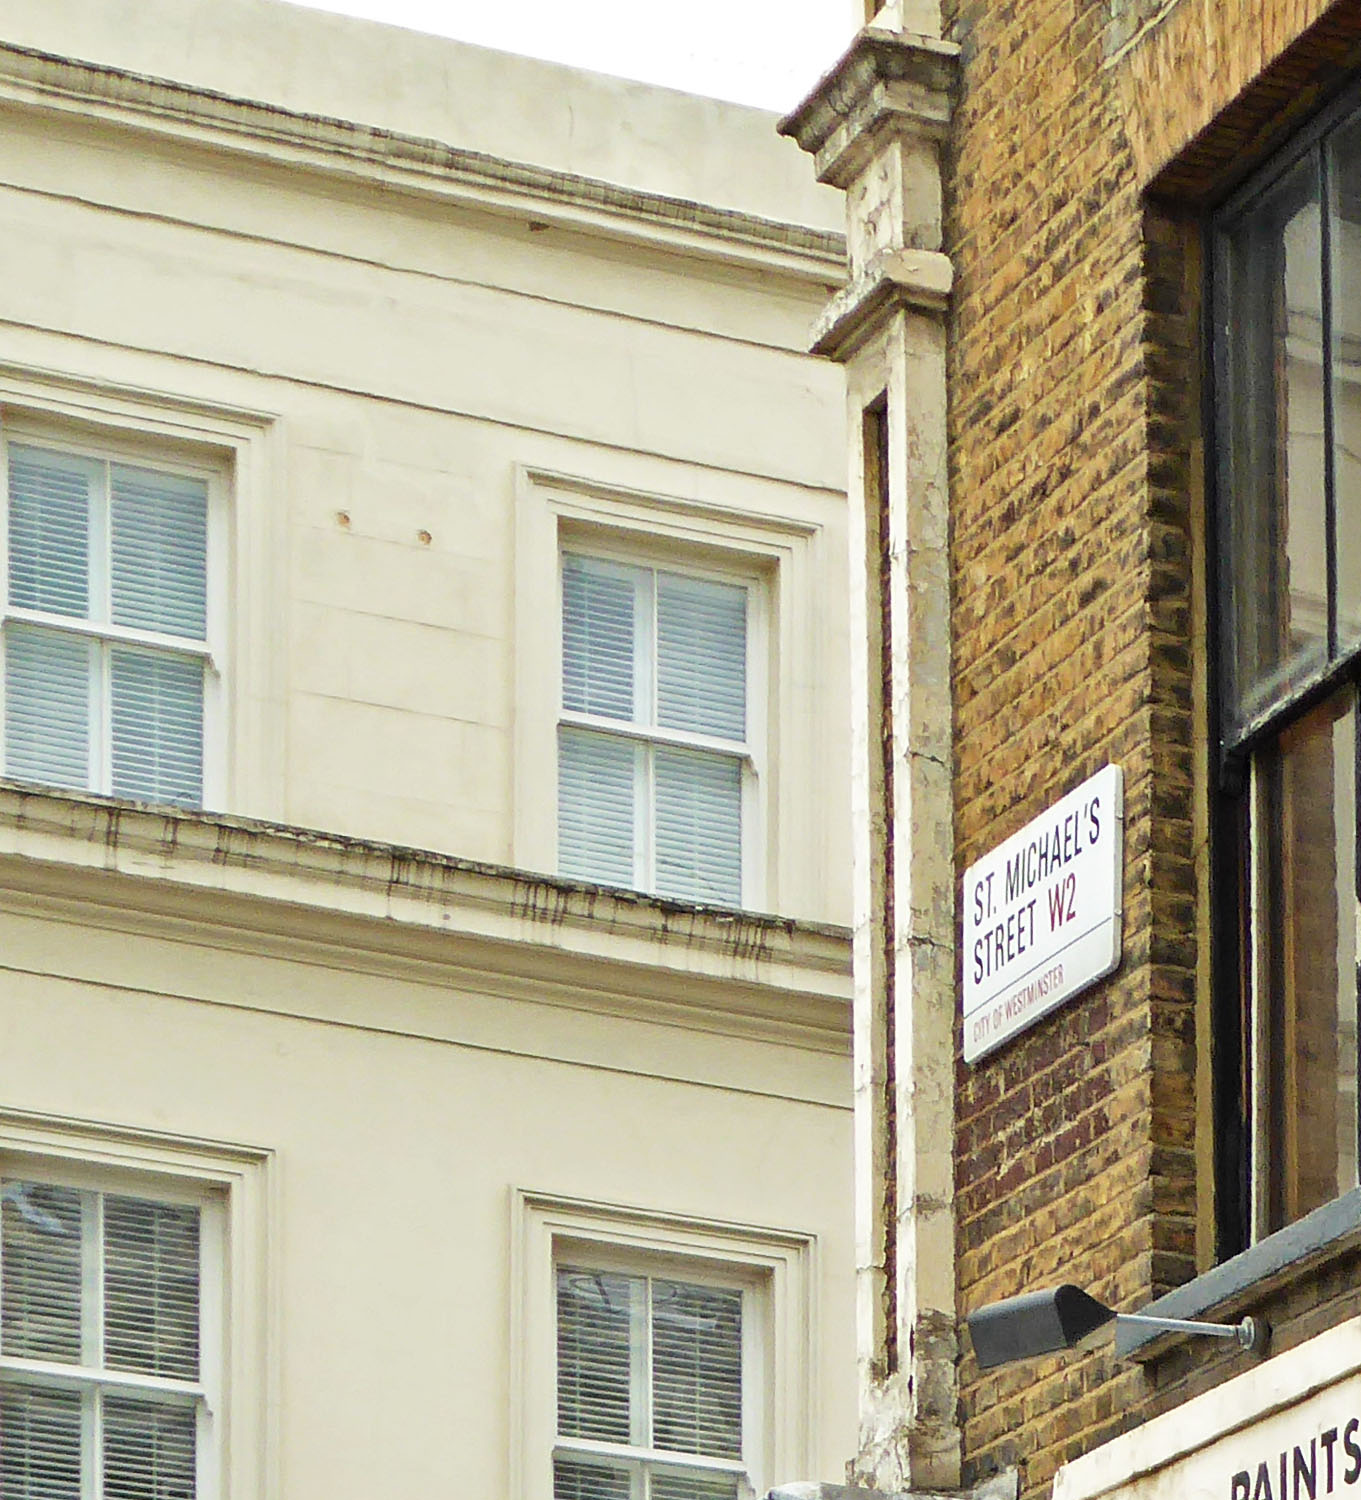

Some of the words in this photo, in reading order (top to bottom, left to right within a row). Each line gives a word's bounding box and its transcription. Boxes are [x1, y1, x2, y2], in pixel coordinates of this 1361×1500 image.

[974, 871, 997, 926] ST.
[1005, 797, 1100, 905] MICHAEL'S
[974, 899, 1037, 985] STREET
[1048, 872, 1077, 932] W2
[973, 1013, 991, 1043] CITY
[1004, 963, 1065, 1021] WESTMINSTER
